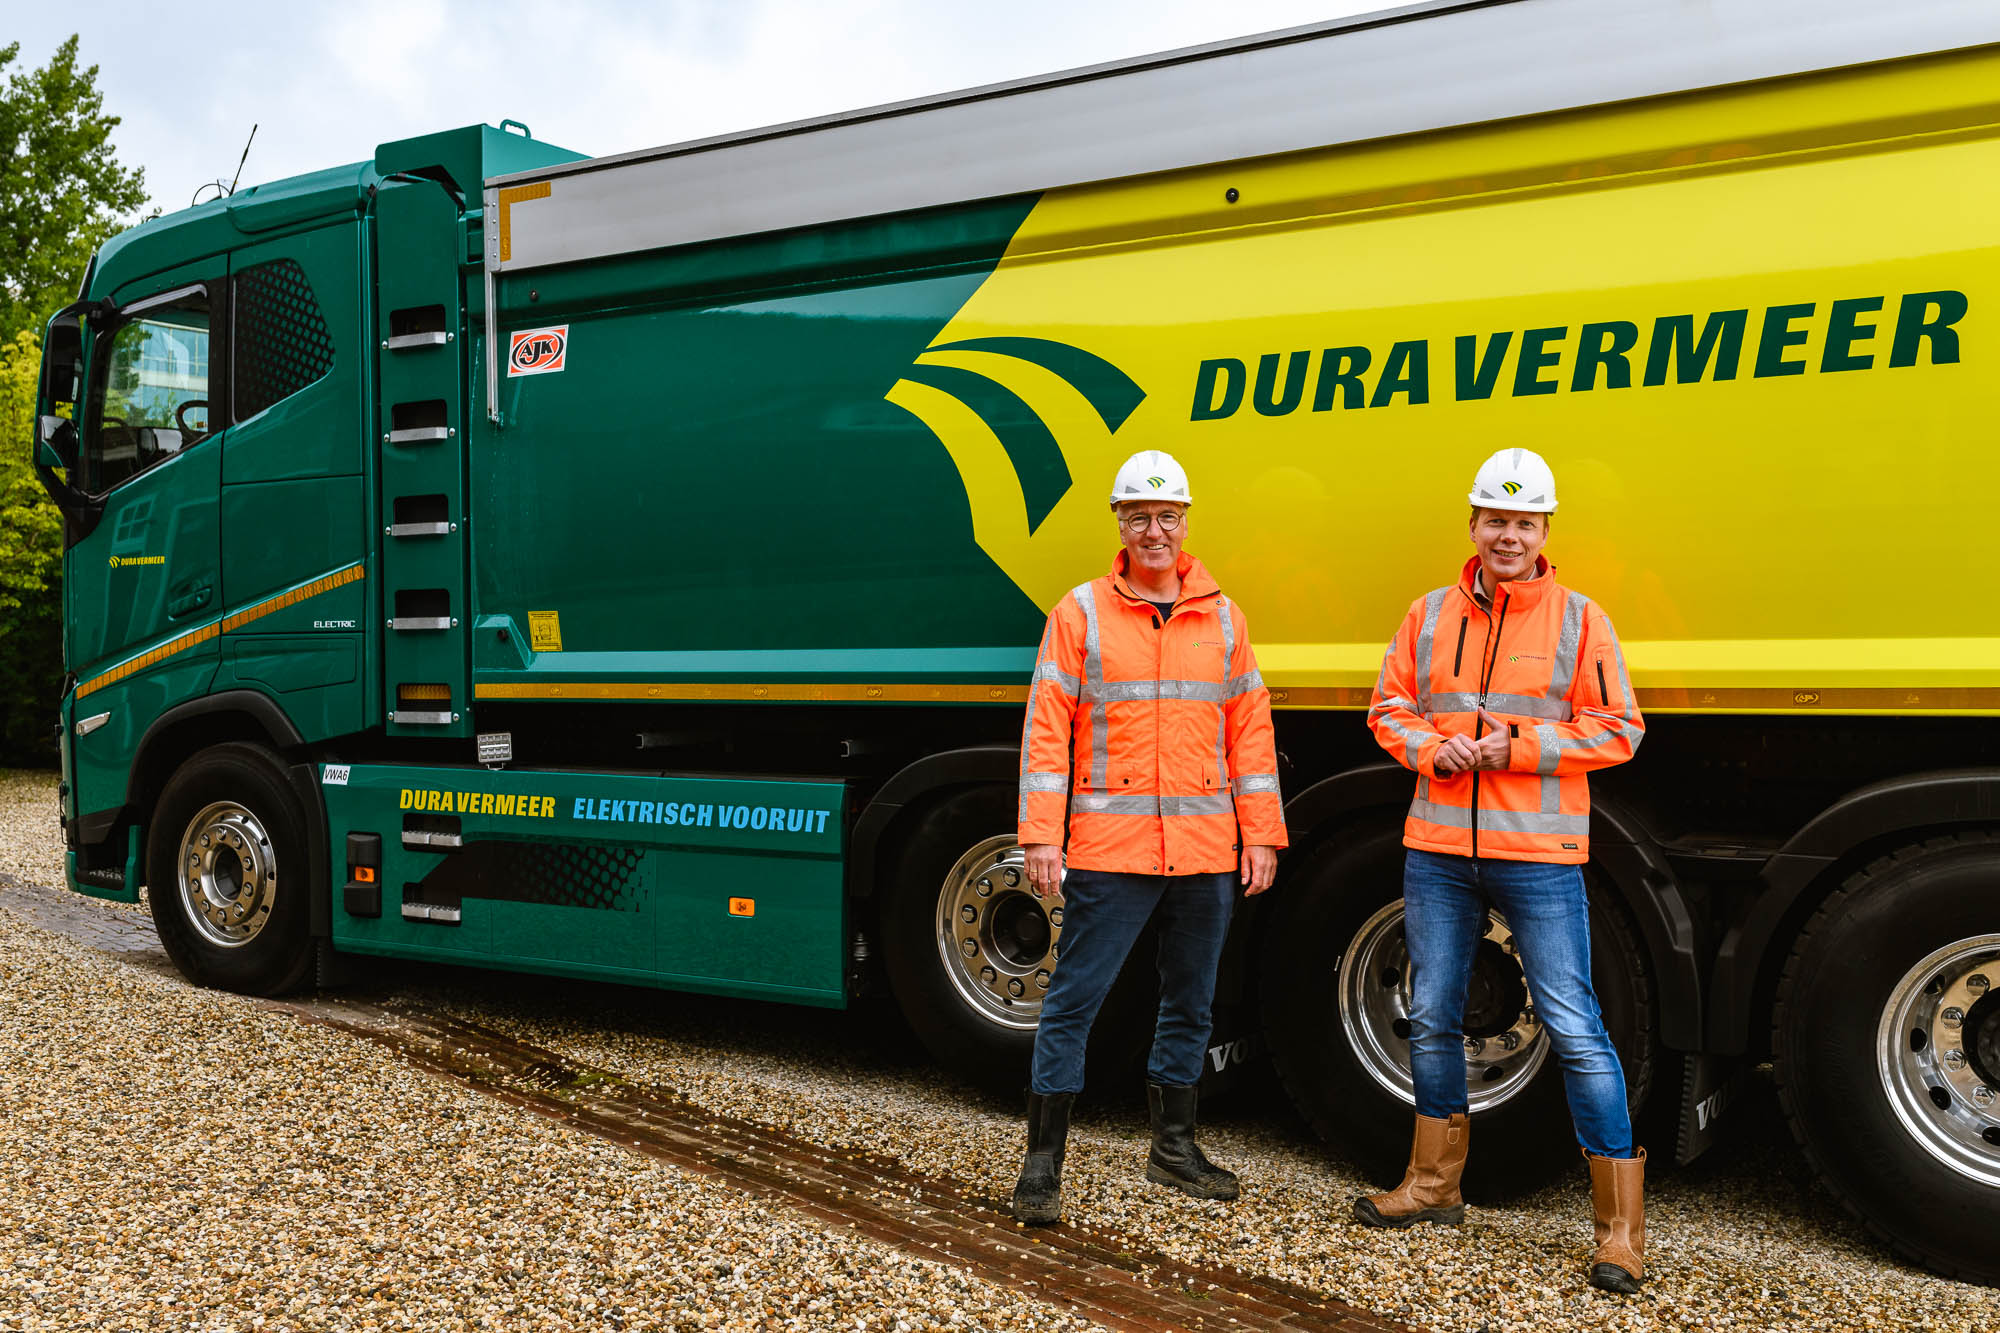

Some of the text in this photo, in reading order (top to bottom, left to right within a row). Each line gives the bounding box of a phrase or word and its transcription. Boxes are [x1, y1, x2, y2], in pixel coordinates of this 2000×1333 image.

[519, 338, 554, 365] AJK
[1190, 290, 1969, 422] DURA VERMEER
[313, 620, 356, 628] ELECTRIC
[325, 769, 348, 781] VWA6
[400, 789, 830, 833] DURA VERMEER ELEKTRISCH VOORUIT
